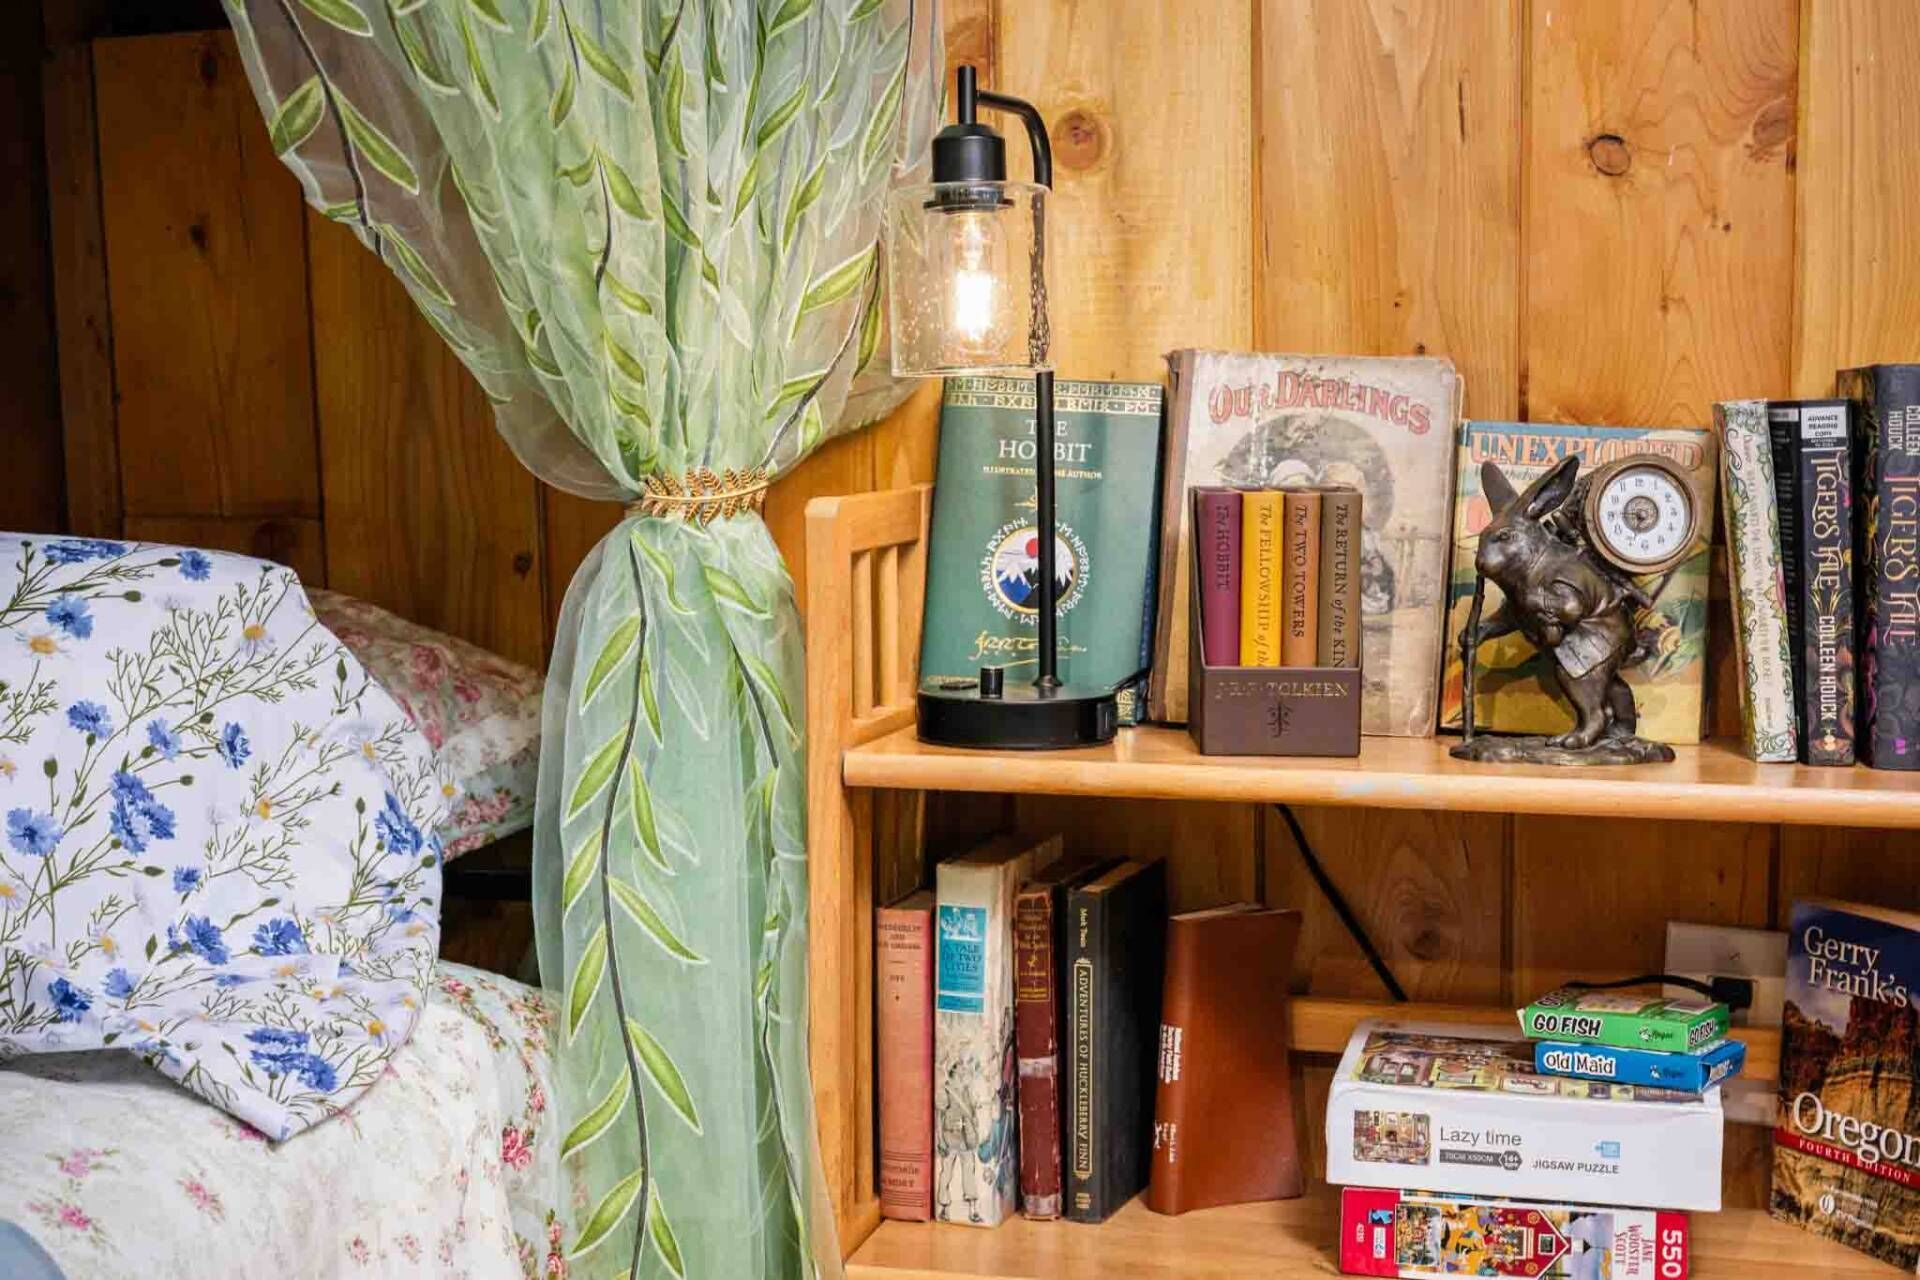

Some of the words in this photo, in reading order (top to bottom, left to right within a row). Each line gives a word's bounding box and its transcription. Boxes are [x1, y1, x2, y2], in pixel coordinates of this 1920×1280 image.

[1275, 370, 1431, 435] DARLINGS
[1025, 419, 1069, 436] TE
[1888, 410, 1903, 451] HOUCK
[999, 439, 1093, 462] HOBIT
[1260, 504, 1272, 526] The
[1295, 504, 1308, 526] The
[1336, 504, 1349, 526] The
[1810, 451, 1843, 539] TIGER'S
[1294, 528, 1307, 567] TWO
[1883, 474, 1920, 582] TIGER'S
[1216, 528, 1230, 592] HOBBIT
[1258, 529, 1272, 631] FELLOWSHIP
[1334, 527, 1348, 595] RETURN
[1811, 540, 1844, 590] TALE
[1292, 572, 1306, 638] TOWERS
[1331, 599, 1346, 615] of
[1334, 613, 1346, 633] the
[1254, 635, 1269, 652] of
[1333, 638, 1346, 667] KIN
[1819, 615, 1836, 673] COLLEEN
[1820, 675, 1837, 721] HOUCK
[1804, 926, 1880, 979] Gerry
[1807, 956, 1908, 1009] Frank's
[1080, 969, 1088, 1041] ADVENTURES
[1533, 1012, 1559, 1033] GO
[1560, 1015, 1603, 1037] FISH
[1080, 1044, 1088, 1058] OF
[1688, 1027, 1700, 1046] GO
[1700, 1018, 1714, 1040] FISH
[1545, 1052, 1570, 1071] Old
[1576, 1054, 1614, 1074] Maid
[1079, 1062, 1088, 1140] HUCKLEBERRY
[1440, 1126, 1480, 1147] Lazy
[1485, 1130, 1522, 1146] time
[1792, 1091, 1920, 1170] Oregon
[1079, 1143, 1088, 1169] FINN
[1532, 1159, 1575, 1172] JIGSAW
[1577, 1162, 1620, 1174] PUZZLE
[1800, 1138, 1851, 1164] FOURTH
[1856, 1160, 1912, 1183] EDITION
[1614, 1231, 1627, 1266] SCOTT
[1626, 1224, 1642, 1276] WOOSTER
[1641, 1239, 1655, 1264] JANE
[1660, 1228, 1684, 1278] 550
